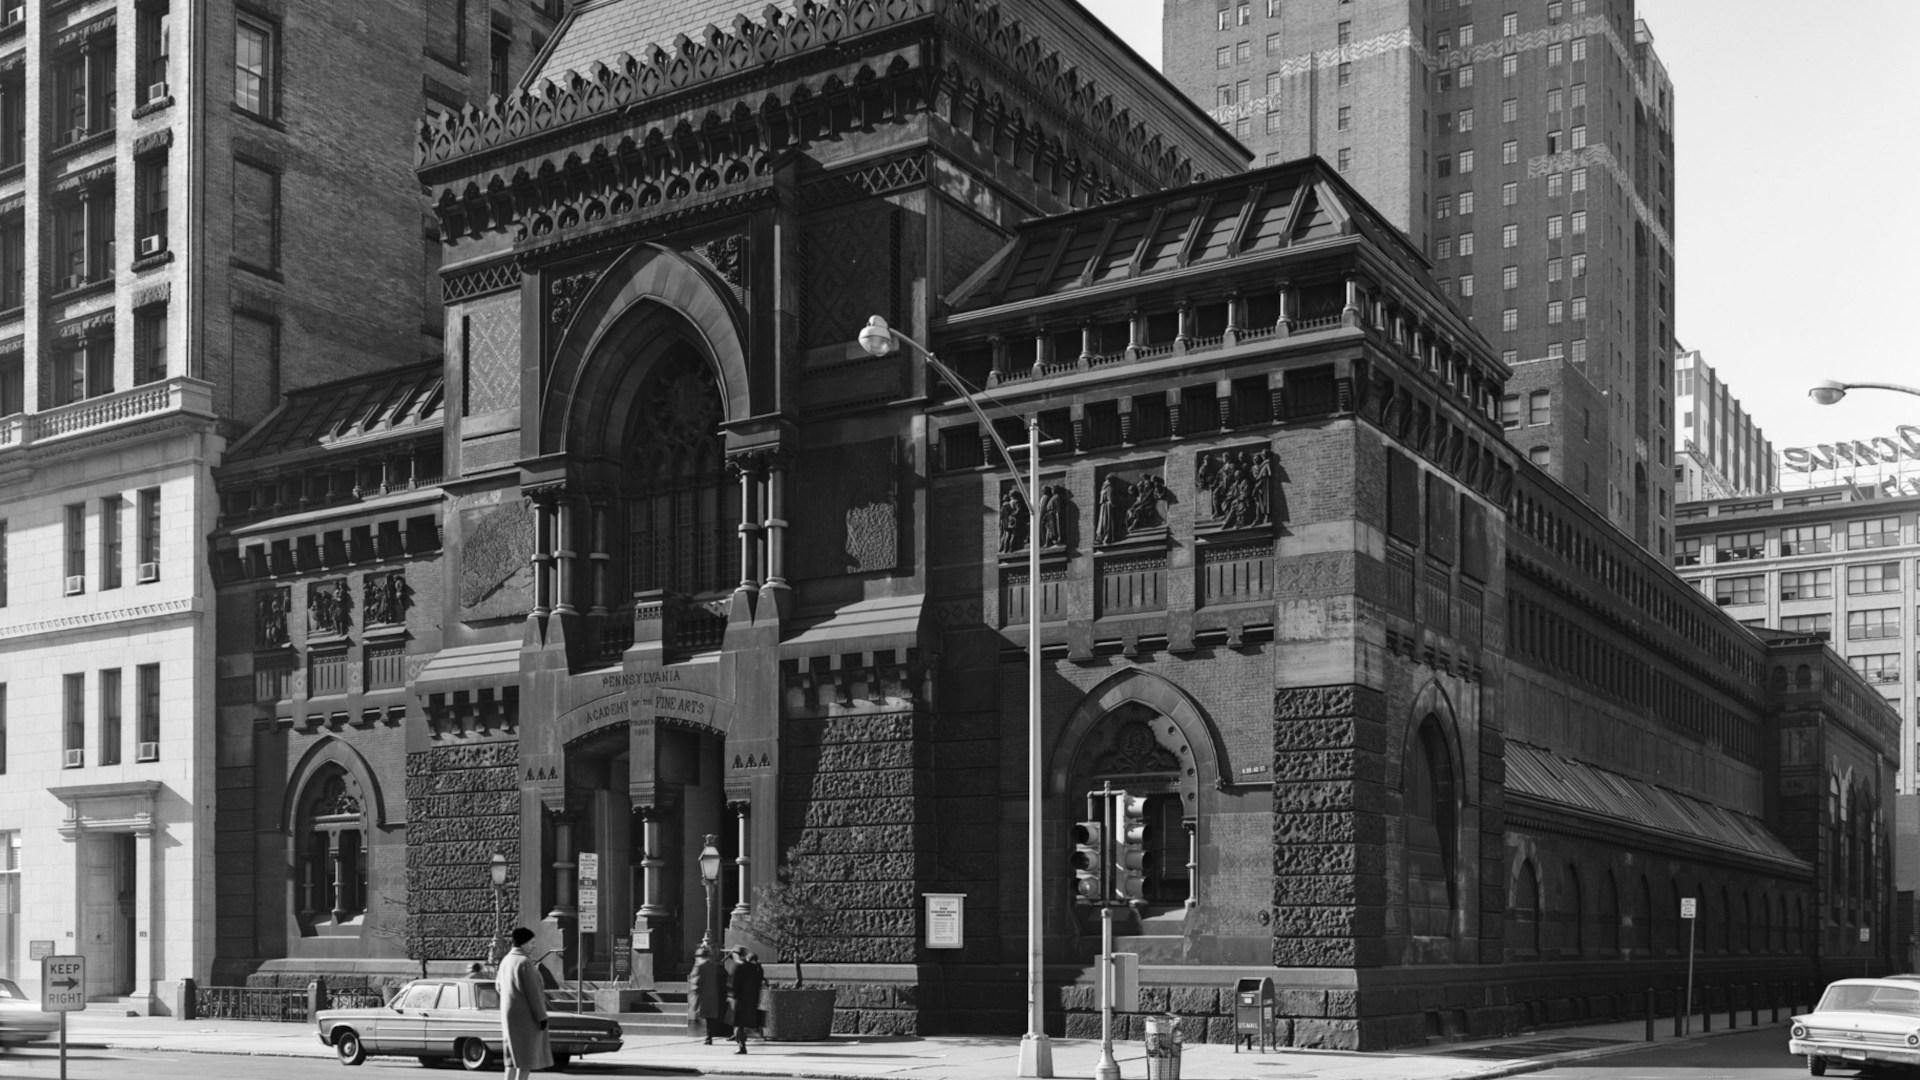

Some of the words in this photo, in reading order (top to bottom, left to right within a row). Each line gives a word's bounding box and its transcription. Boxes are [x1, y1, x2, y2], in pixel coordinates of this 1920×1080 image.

[602, 670, 680, 688] PENNSYLVANIA
[586, 701, 629, 723] ACADEMY
[655, 696, 677, 710] FINE
[678, 697, 705, 714] ARTS
[50, 964, 80, 975] KEEP
[48, 993, 82, 1004] RIGHT
